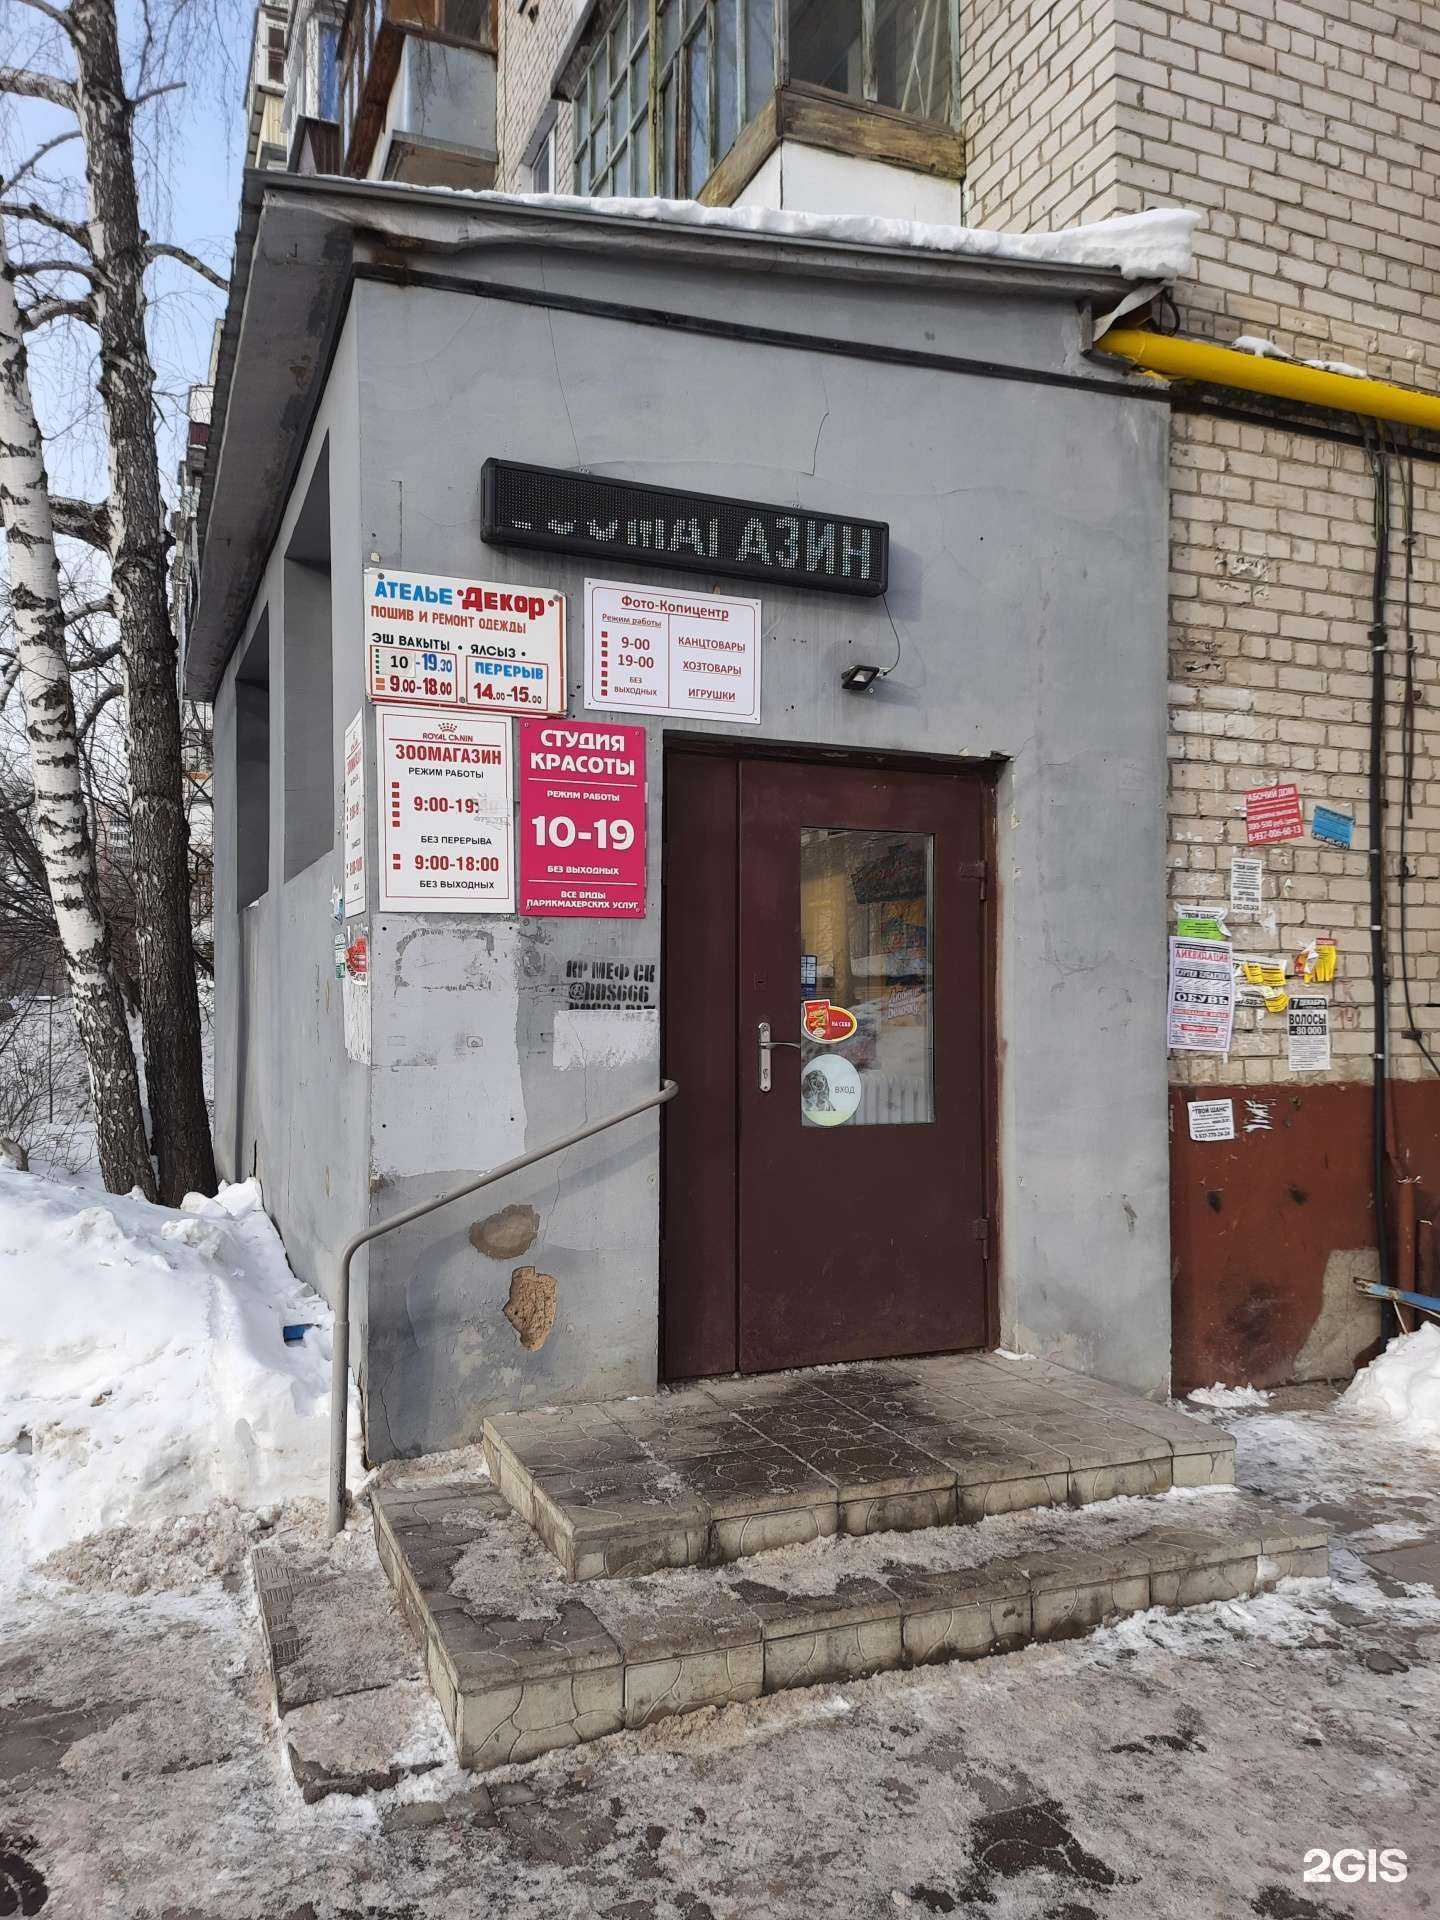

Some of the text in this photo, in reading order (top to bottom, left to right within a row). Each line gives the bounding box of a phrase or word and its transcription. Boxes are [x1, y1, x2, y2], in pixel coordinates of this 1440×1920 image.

[374, 578, 453, 606] АТЕЛЬЕ
[621, 594, 729, 621] Фото-Копицентр
[370, 604, 526, 634] ПОШИВ И РЕМОНТ ОДЕЖДЫ
[602, 613, 662, 628] Режим работы
[371, 632, 516, 658] ЭШ ВАКЫТЫ ЯЛСЫЗ
[621, 636, 650, 650] 9-00
[678, 636, 745, 652] КАНЦТОВАРЫ
[390, 655, 408, 669] 10
[617, 654, 654, 669] 19-00
[683, 660, 742, 675] ХОЗТОВАРЫ
[475, 661, 544, 680] ПЕРЕРЫВ
[629, 676, 642, 684] БЕЗ
[614, 686, 657, 696] ВЫХОДНЫХ
[688, 688, 736, 701] ИГРУШКИ
[422, 732, 473, 742] ROYAL CANIN
[540, 729, 625, 752] СТУДИЯ
[395, 744, 502, 765] ЗООМАГАЗИН
[530, 753, 635, 776] КРАСОТЫ
[408, 767, 484, 779] РЕЖИМ РАБОТЫ
[547, 790, 620, 802] РЕЖИМ РАБОТЫ
[531, 815, 635, 850] 10-19
[421, 835, 492, 845] БЕЗ ПЕРЕРЫВА
[414, 854, 499, 872] 9:00-18:00
[547, 865, 620, 875] БЕЗ ВЫХОДНЫХ
[420, 880, 494, 890] БЕЗ ВЫХОДНЫХ
[561, 890, 606, 899] ВСЕ ВИДЫ
[527, 899, 638, 910] ПАРИКМАХЕРСКИХ УСЛУГ
[1175, 991, 1229, 1005] ОБУВЬ
[1288, 1013, 1327, 1025] ВОЛОСЫ
[834, 1086, 856, 1094] ВХОД
